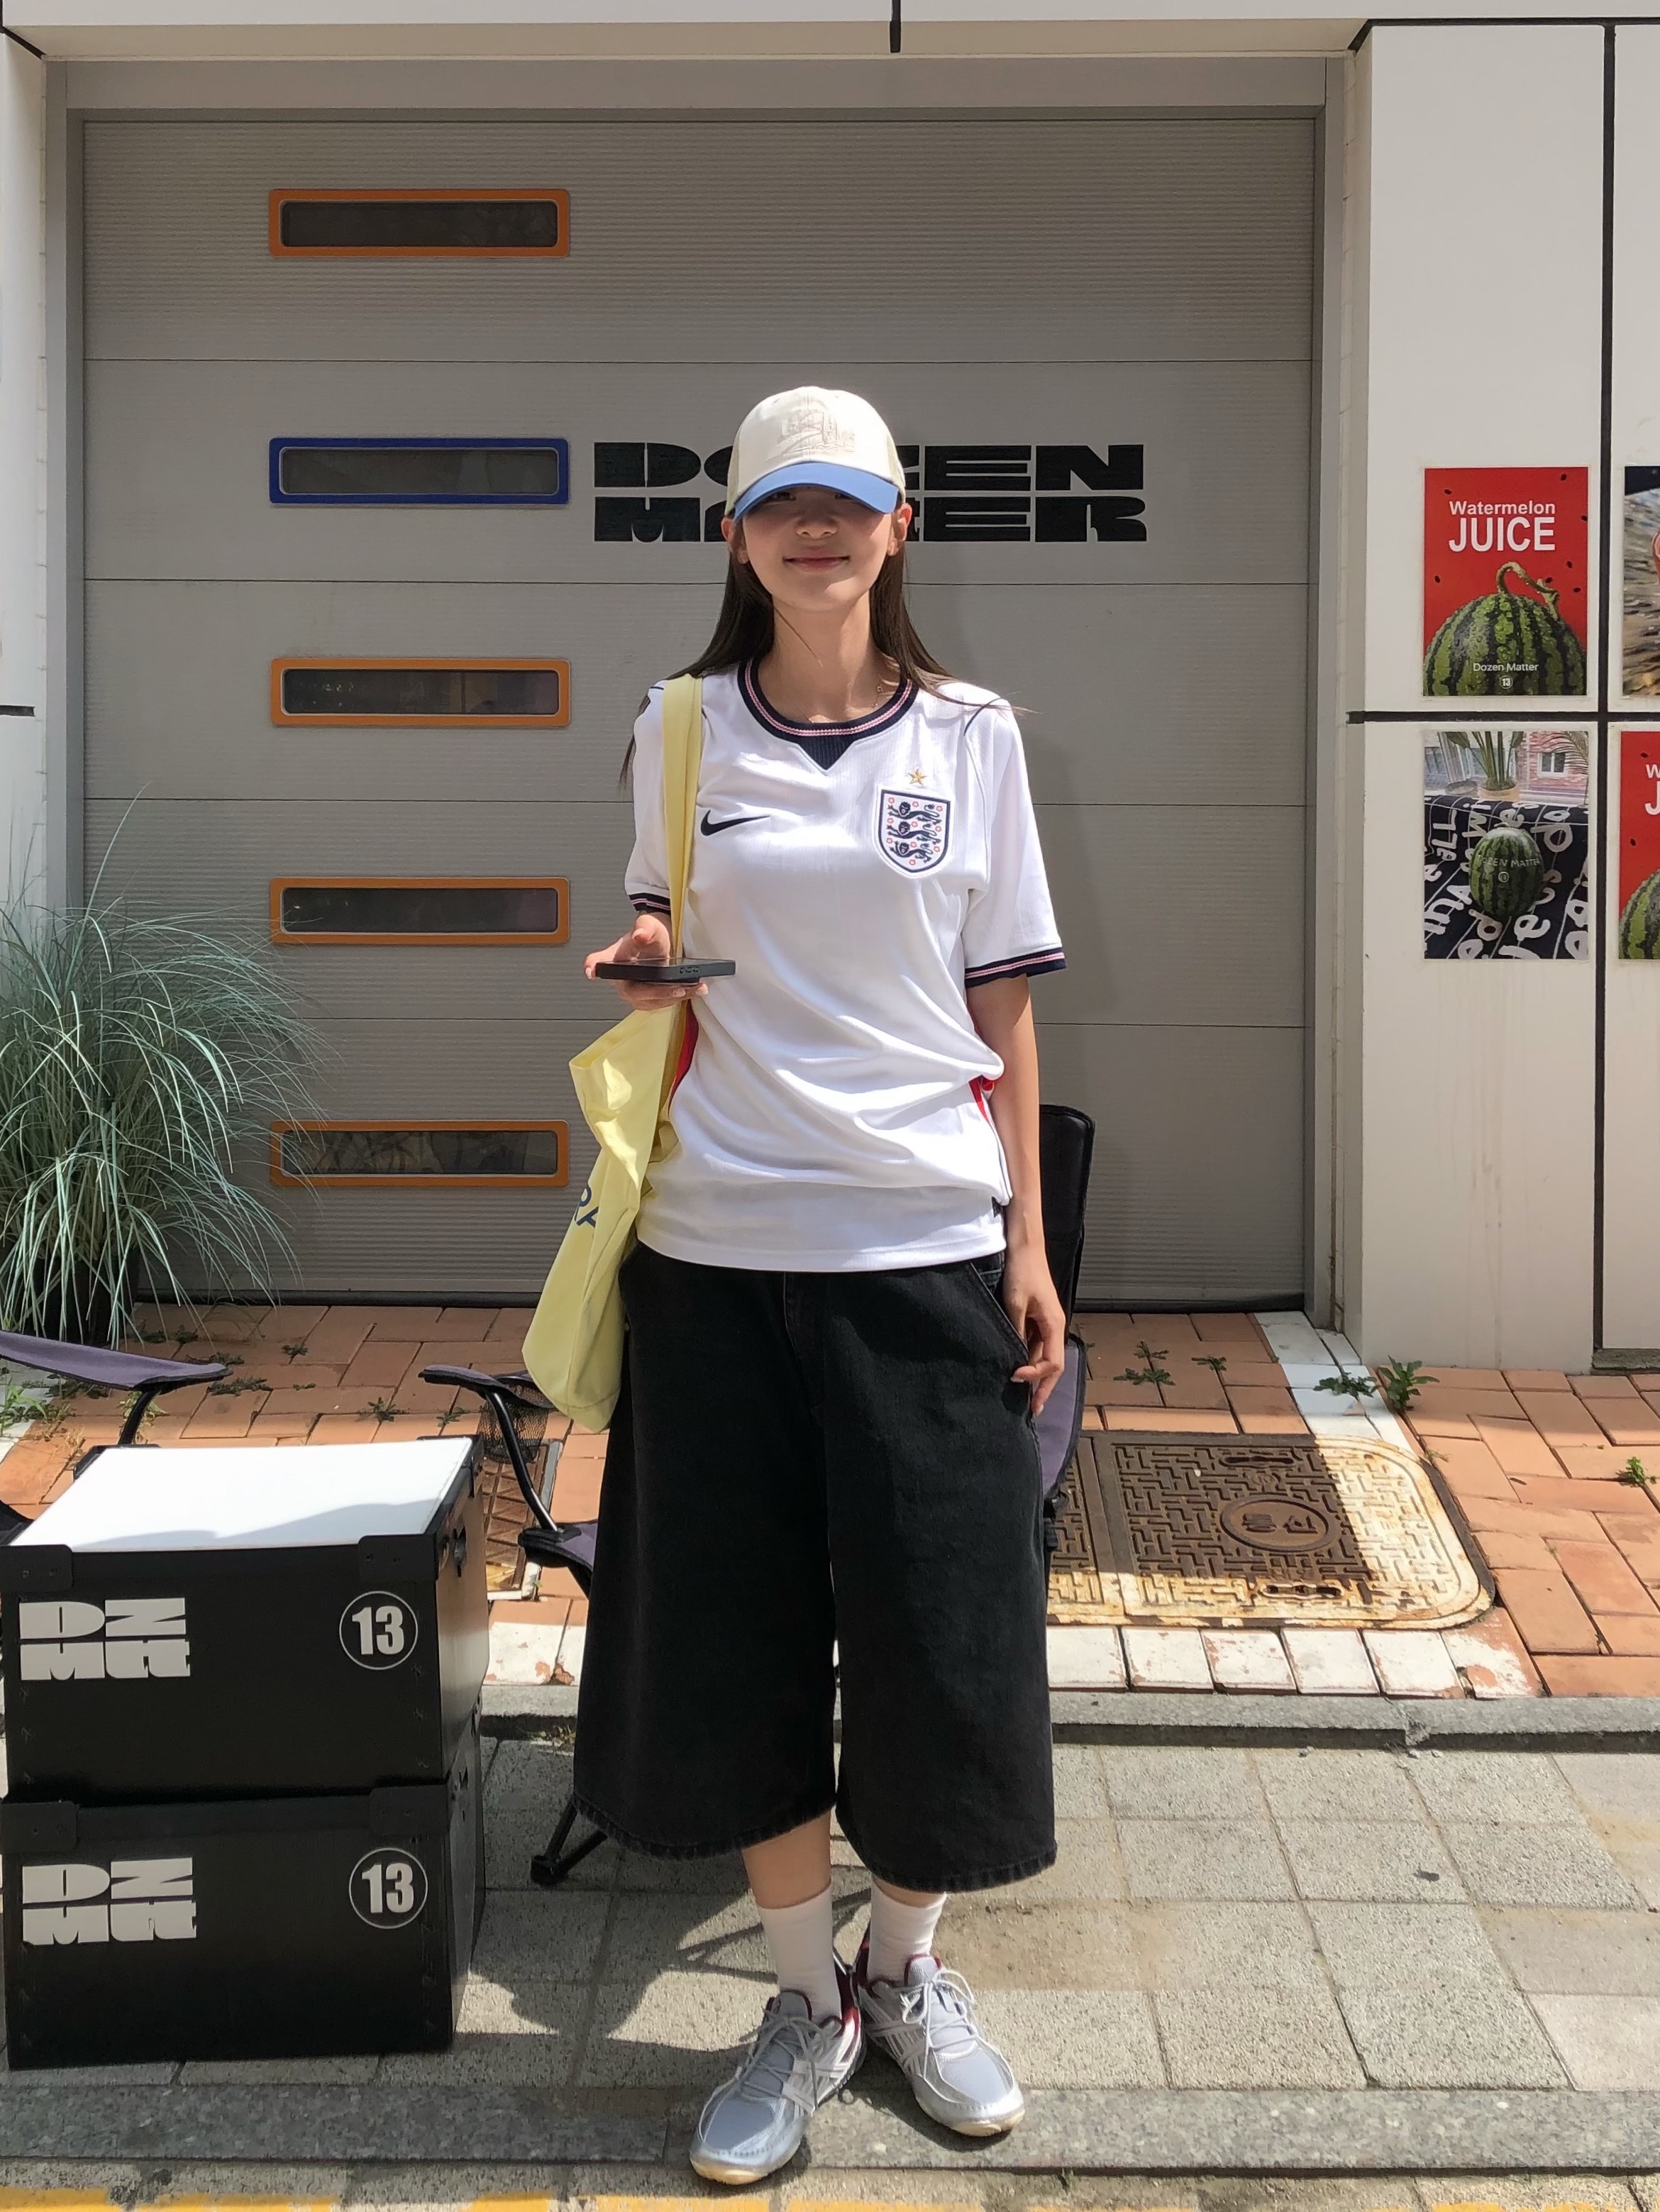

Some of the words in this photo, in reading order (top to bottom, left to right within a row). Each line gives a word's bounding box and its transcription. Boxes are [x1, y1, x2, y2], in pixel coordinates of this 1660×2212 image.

[594, 441, 1144, 492] DEN
[1449, 499, 1556, 515] Watermelon
[1448, 516, 1556, 552] JUICE
[1473, 663, 1504, 672] Dozen
[1506, 663, 1539, 673] Matter
[1502, 678, 1511, 687] 13
[19, 1598, 187, 1640] DZ
[352, 1605, 405, 1655] 13
[22, 1857, 194, 1904] DZ
[362, 1862, 414, 1913] 13
